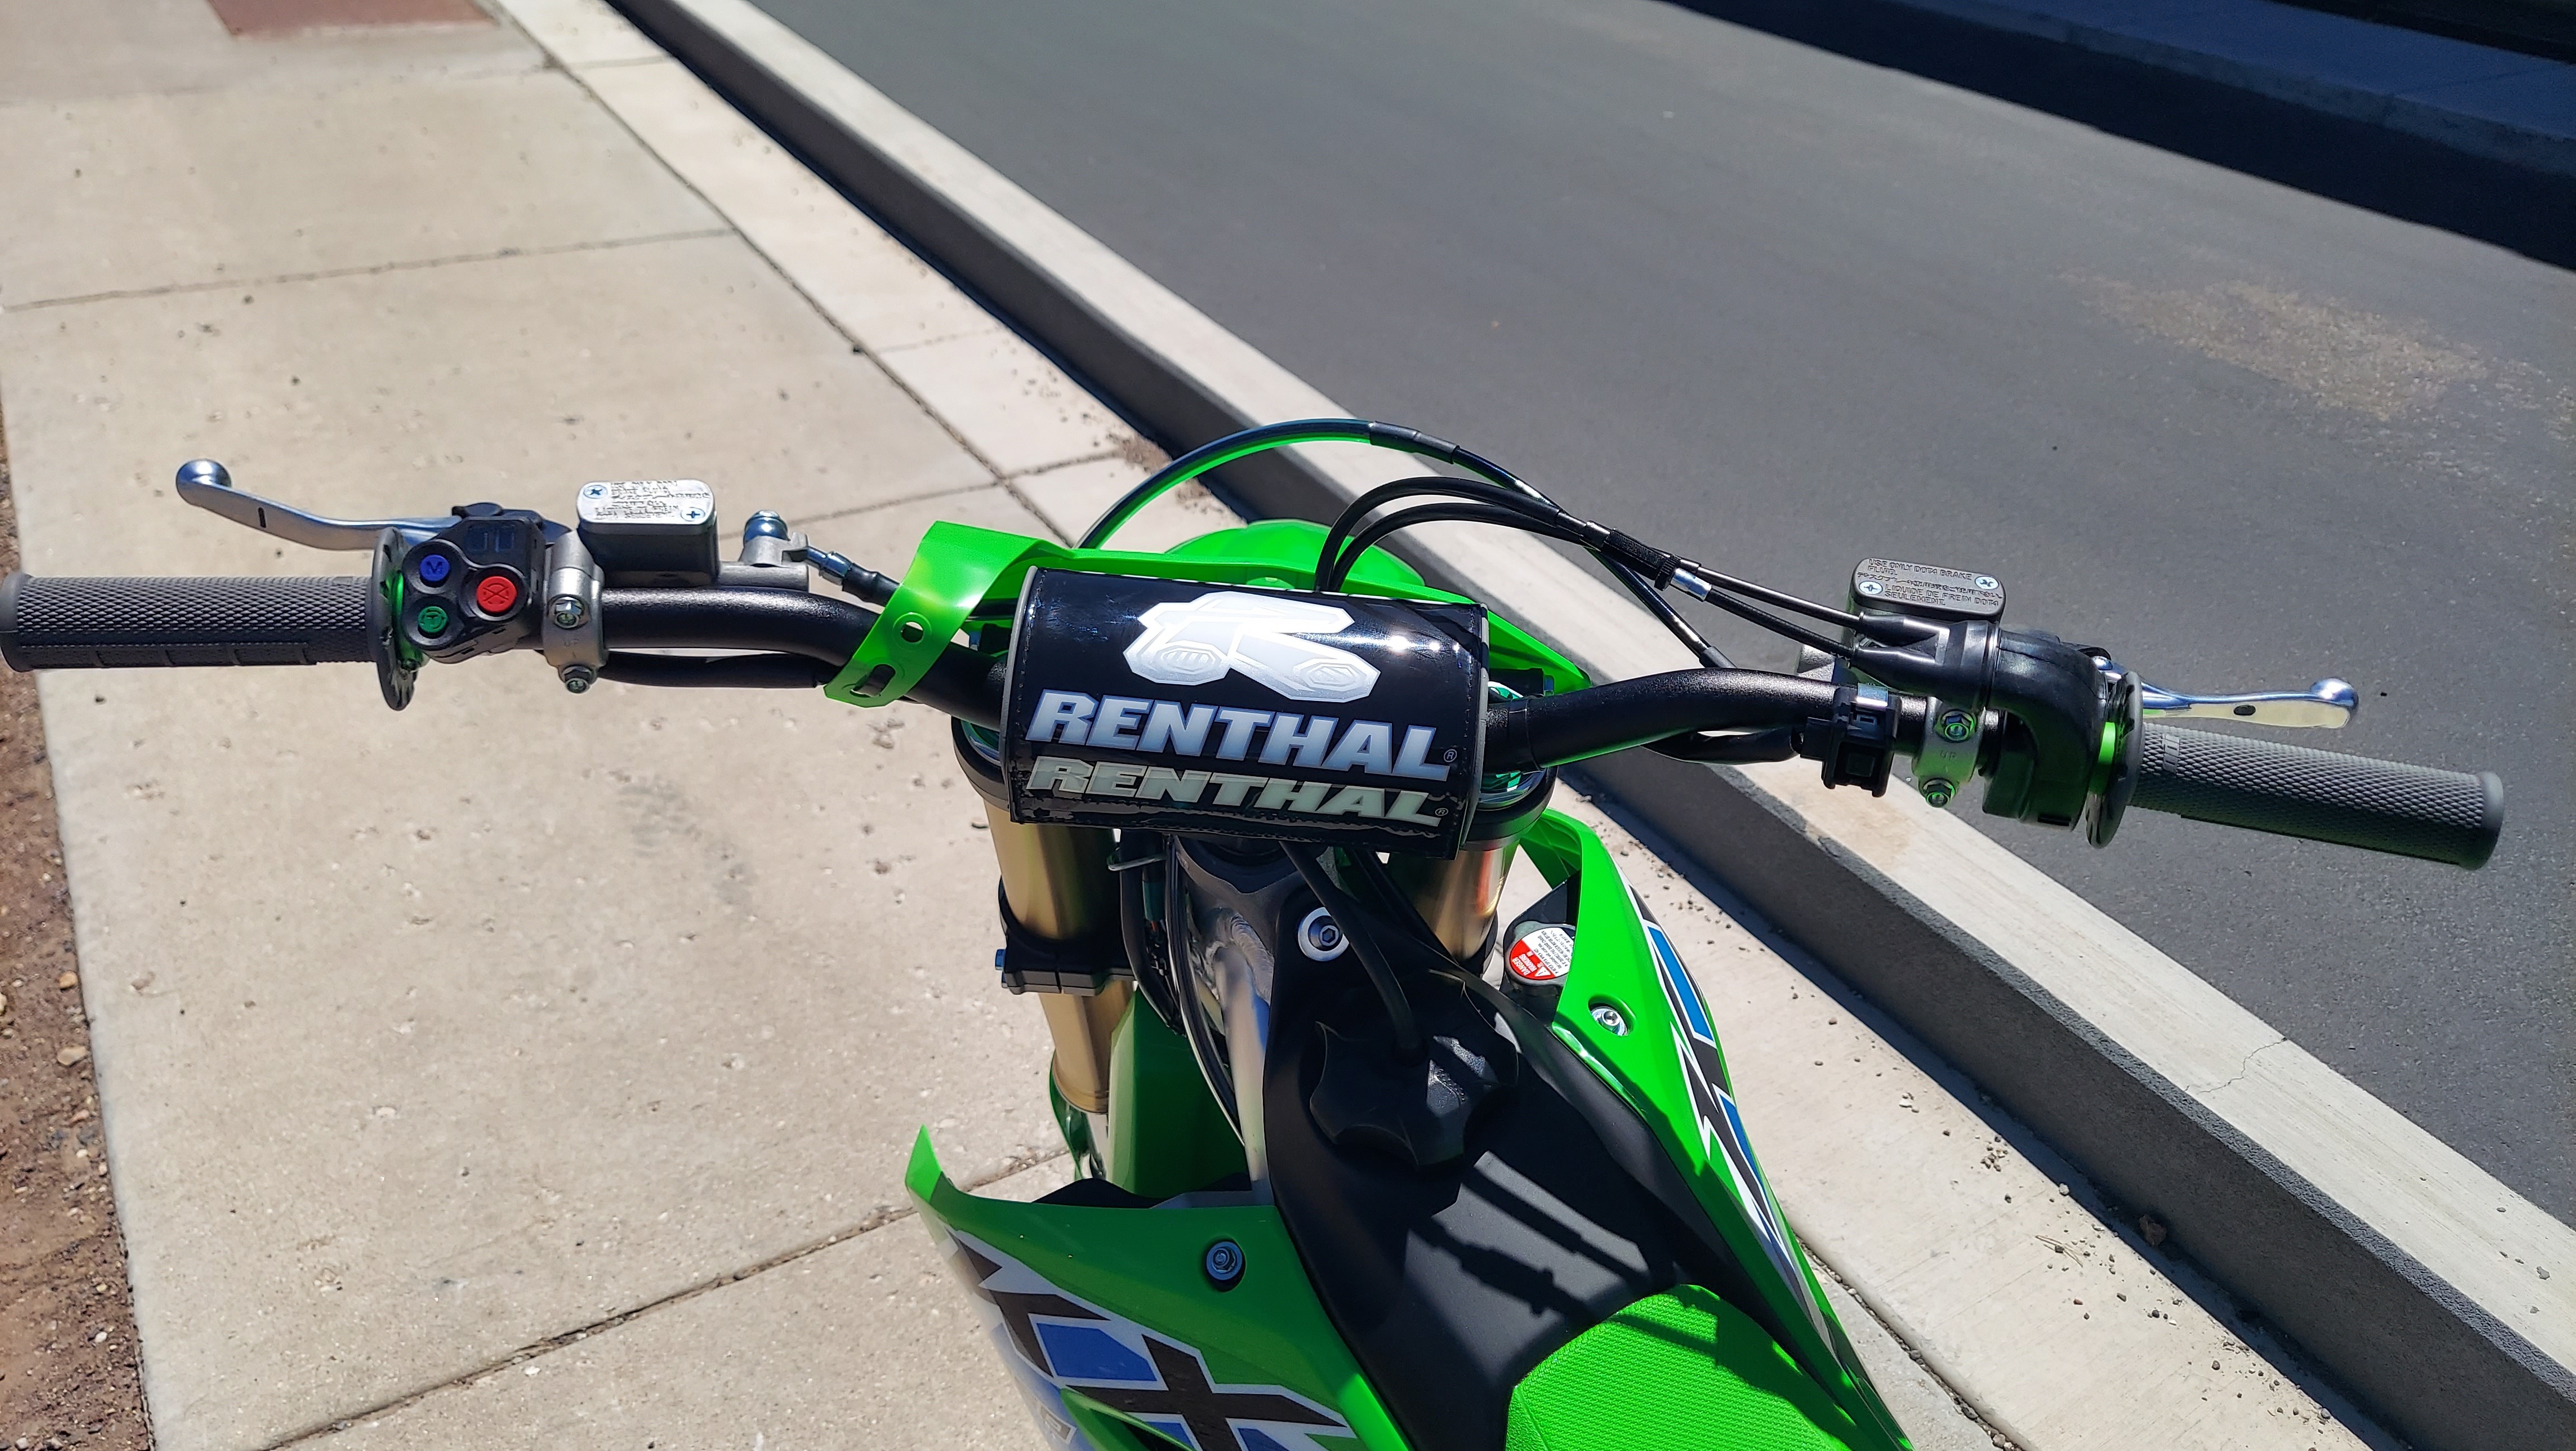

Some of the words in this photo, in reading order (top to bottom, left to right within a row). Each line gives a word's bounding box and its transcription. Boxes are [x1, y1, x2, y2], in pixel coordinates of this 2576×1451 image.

[1868, 558, 1887, 567] USE
[1889, 562, 1913, 571] ONLY
[1914, 565, 1938, 574] DOT4
[1939, 569, 1972, 580] BRAKE
[1885, 583, 1924, 596] LIQUIDE
[1926, 590, 1940, 598] DE
[1942, 592, 1972, 602] FREIN
[1974, 596, 1999, 607] DOT4
[1512, 957, 1531, 976] DANGER
